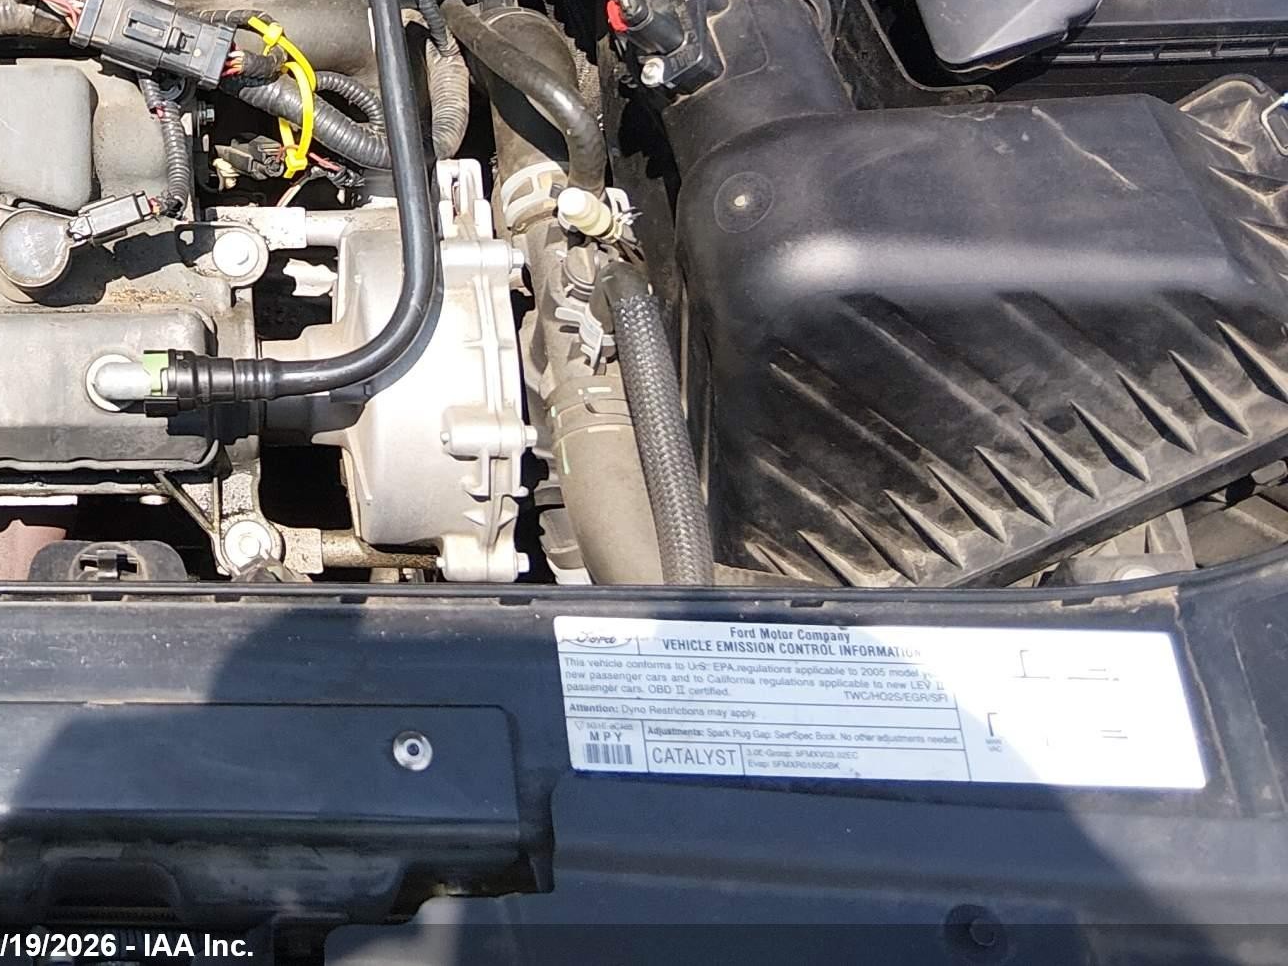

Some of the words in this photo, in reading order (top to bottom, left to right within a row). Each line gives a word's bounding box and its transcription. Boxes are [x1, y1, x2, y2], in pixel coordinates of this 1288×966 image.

[730, 627, 756, 639] Ford
[760, 628, 794, 640] Motor
[797, 629, 851, 644] Company
[663, 639, 712, 652] VEHICLE
[716, 641, 775, 655] EMISSION
[779, 643, 836, 656] CONTROL
[564, 657, 585, 667] This
[588, 658, 623, 668] vehicle
[626, 660, 672, 670] conforms
[675, 661, 685, 671] to
[795, 666, 845, 677] applicable
[848, 667, 857, 676] to
[861, 667, 886, 677] 2005
[889, 668, 919, 678] model
[565, 672, 585, 680] new
[589, 672, 642, 683] passenger
[645, 674, 668, 682] cars
[671, 673, 690, 683] and
[693, 674, 704, 684] to
[707, 674, 755, 684] California
[759, 676, 815, 688] regulations
[819, 678, 870, 689] applicable
[872, 680, 883, 689] to
[886, 680, 907, 690] new
[910, 679, 931, 690] LEV
[566, 684, 617, 694] passenger
[648, 685, 672, 694] OBD
[675, 685, 686, 695] II
[569, 703, 619, 713] Attention:
[621, 704, 647, 716] Dyno
[649, 705, 705, 716] Restrictions
[707, 708, 728, 718] may
[652, 746, 737, 766] CATALYST
